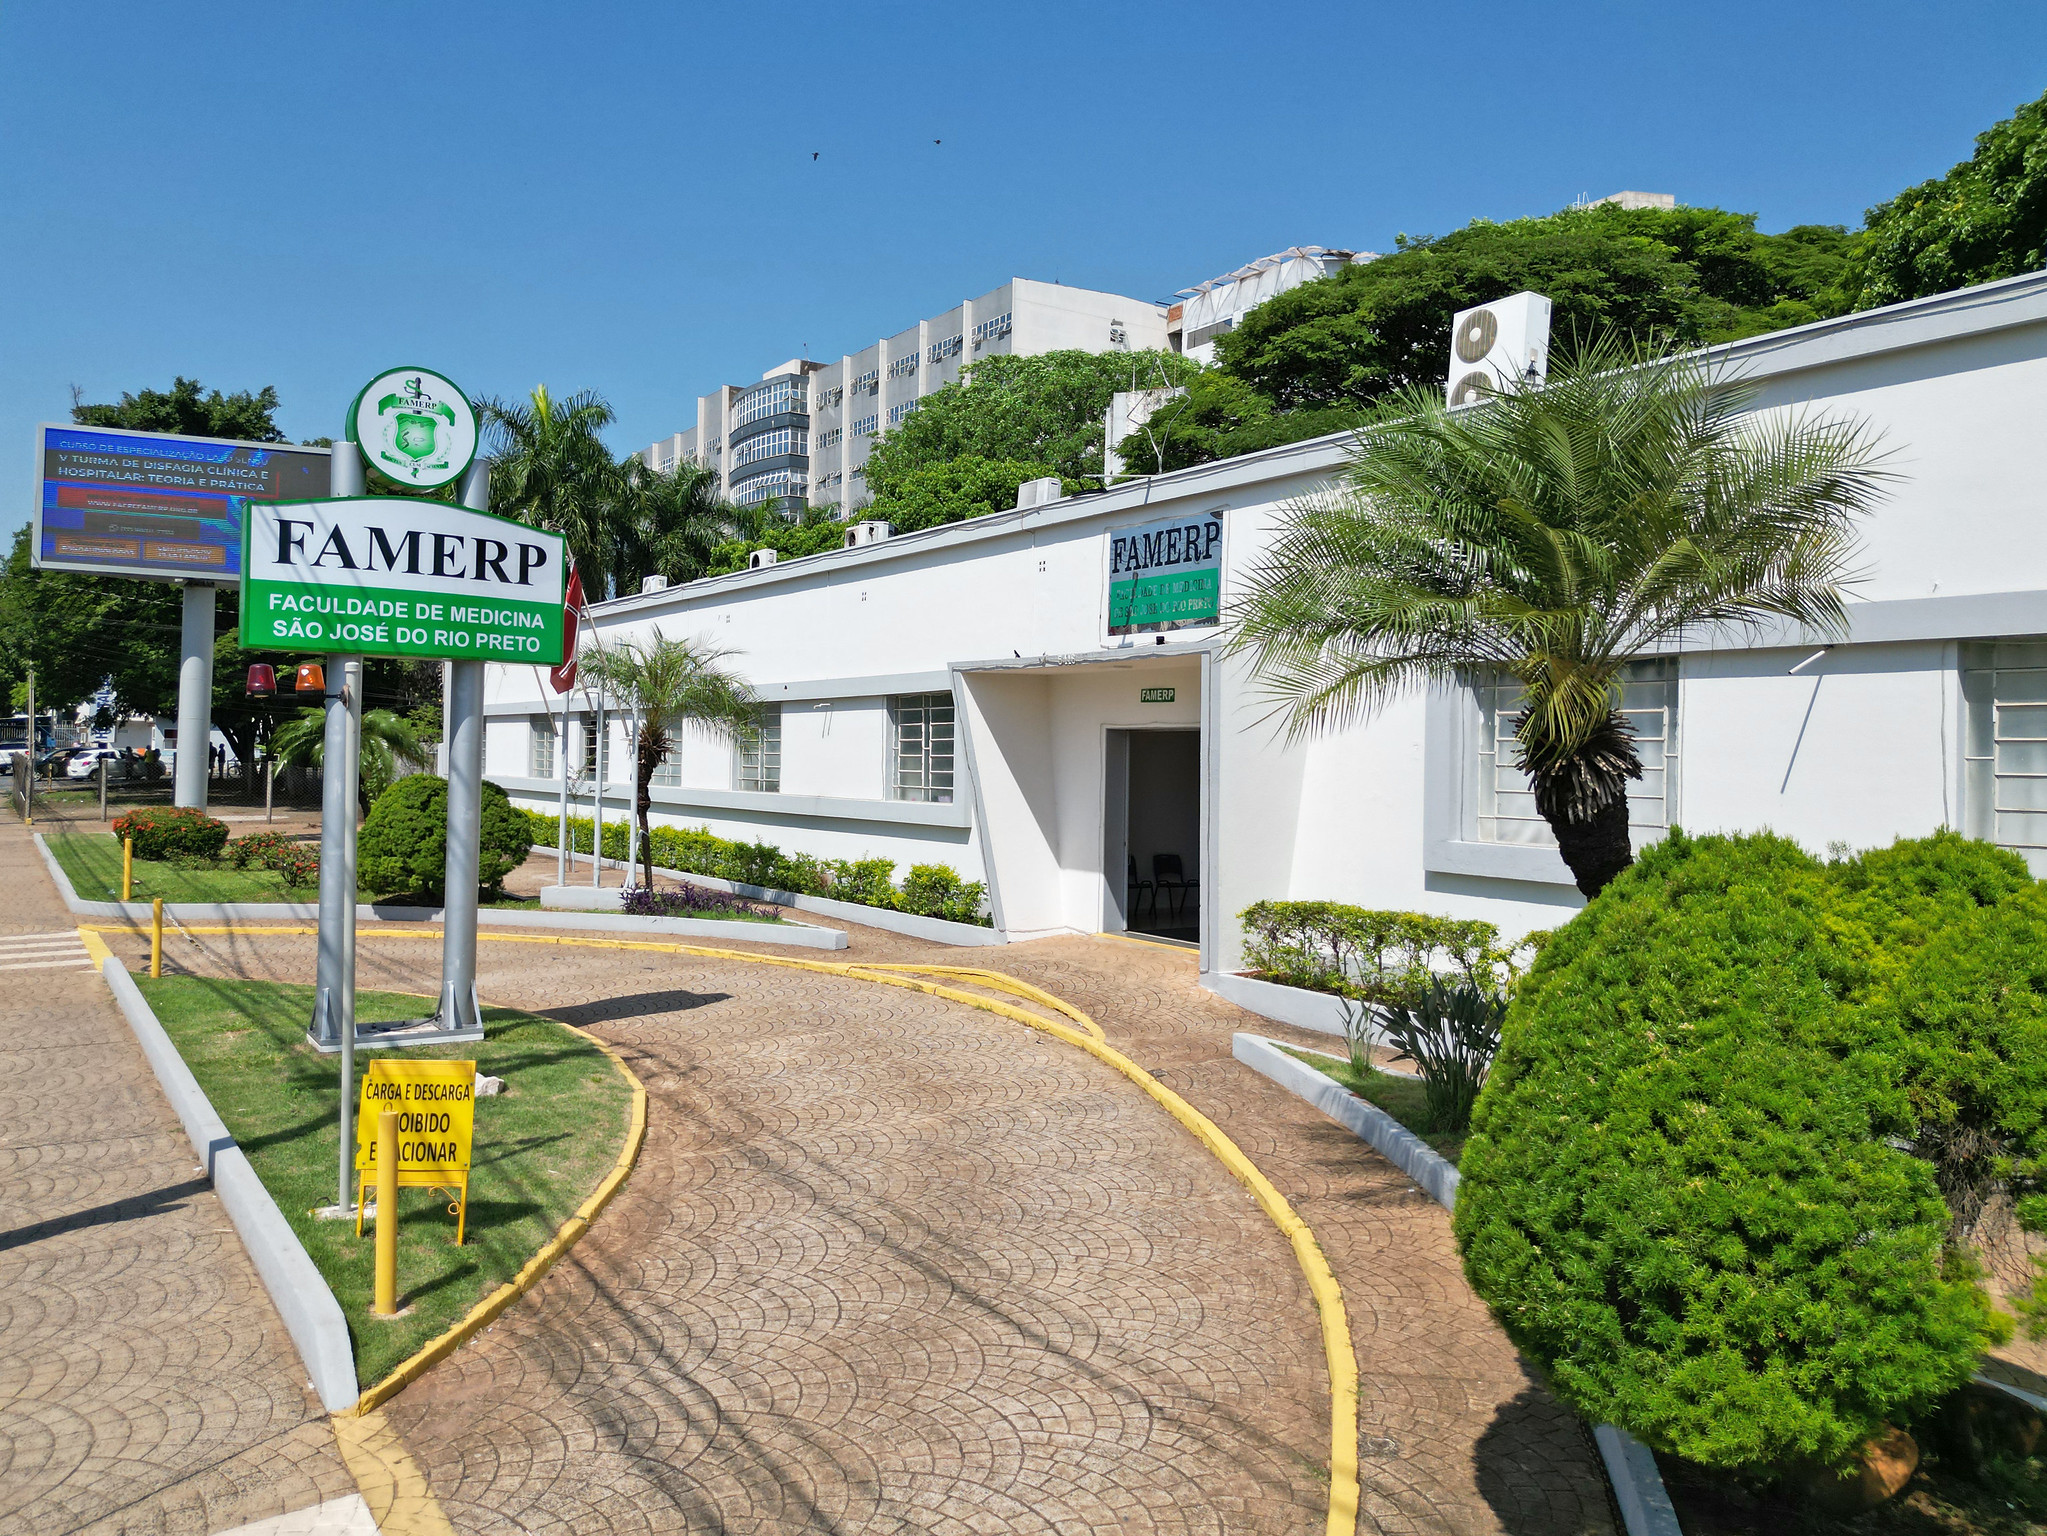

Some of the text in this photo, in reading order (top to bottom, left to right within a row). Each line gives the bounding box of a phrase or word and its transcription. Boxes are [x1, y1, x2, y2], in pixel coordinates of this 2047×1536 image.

[398, 397, 437, 410] FAMERP
[60, 441, 97, 451] CURSO
[99, 444, 115, 452] DE
[72, 455, 118, 466] TURMA
[122, 459, 139, 468] DE
[144, 461, 204, 473] DISFAGIA
[207, 464, 258, 479] CLÍNICA
[261, 470, 269, 480] E
[58, 467, 265, 491] HOSPITALAR: TEORIA E PRÁTICA
[272, 518, 548, 586] FAMERP
[1112, 521, 1220, 574] FAMERP
[269, 593, 545, 629] FACULDADE DE MEDICINA
[272, 617, 540, 653] SÃO JOSÉ DO RIO PRETO
[1142, 690, 1174, 701] FAMERP
[366, 1083, 470, 1101] CARGA E DESCARGA
[398, 1112, 450, 1133] OIBIDO
[369, 1141, 457, 1162] ECIONAR
